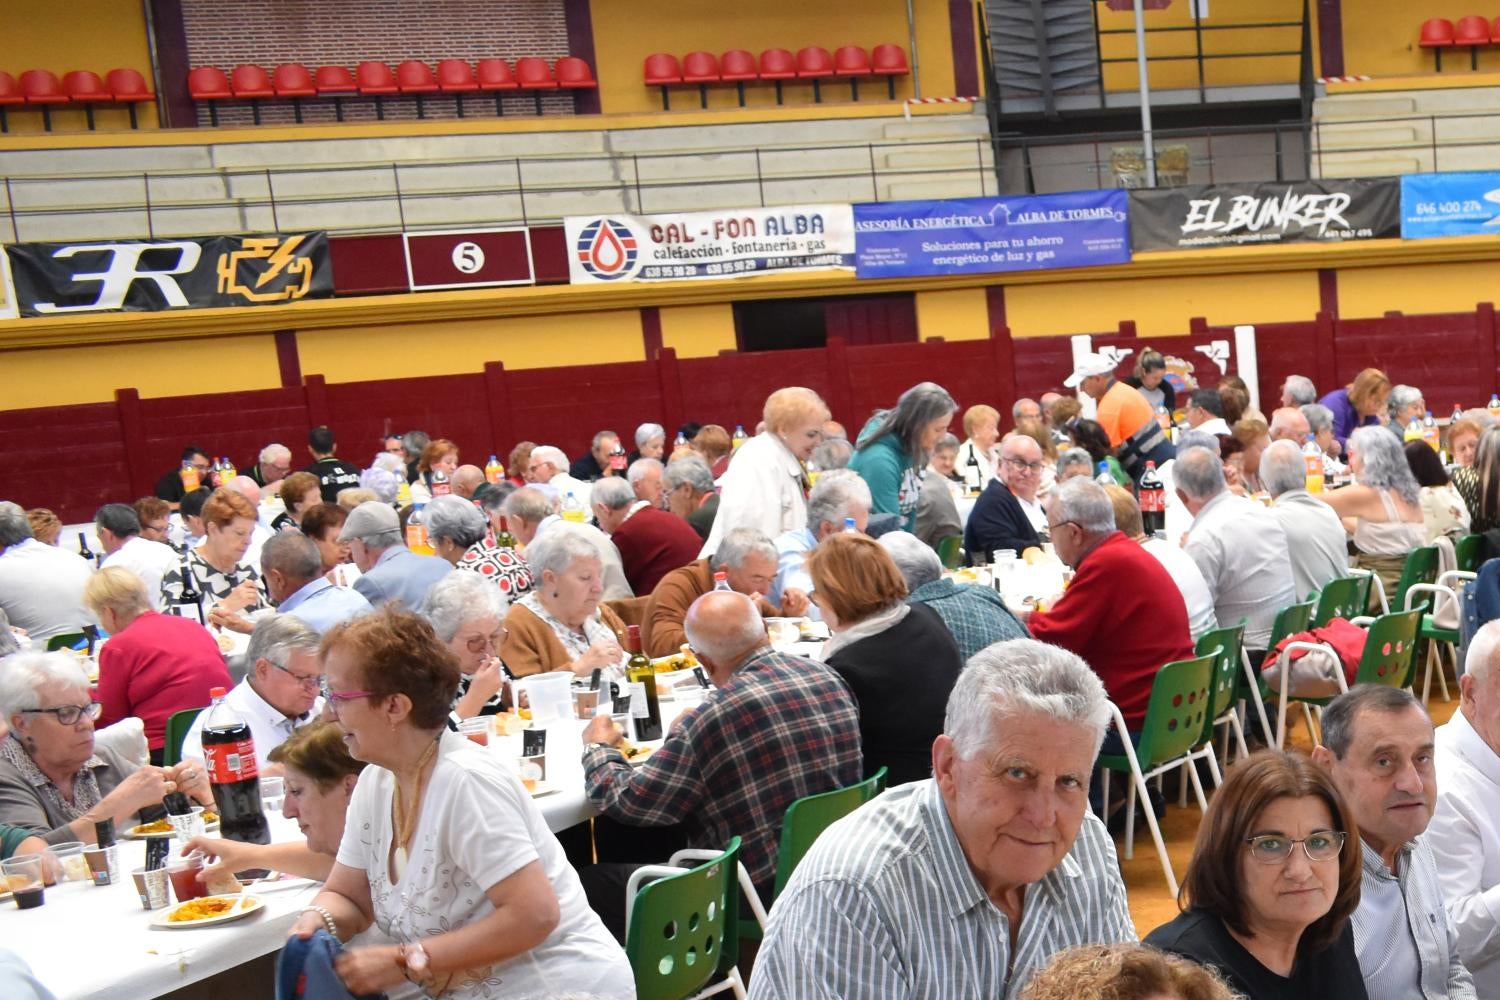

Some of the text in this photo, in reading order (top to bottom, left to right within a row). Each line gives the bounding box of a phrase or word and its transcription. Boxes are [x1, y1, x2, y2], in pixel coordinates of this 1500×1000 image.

[1017, 211, 1047, 223] ALBA
[1050, 210, 1066, 222] DE
[1068, 207, 1113, 220] TORMES
[1181, 185, 1351, 237] EL BUNKER
[651, 222, 695, 244] CAL
[714, 217, 756, 241] FON
[765, 214, 825, 238] ALBA
[808, 240, 826, 253] gas
[922, 236, 1063, 253] Soluciones para tu ahorro
[461, 246, 476, 271] 5
[932, 252, 989, 266] energético
[991, 252, 1005, 263] de
[1007, 251, 1024, 261] luz
[1035, 250, 1055, 262] gas
